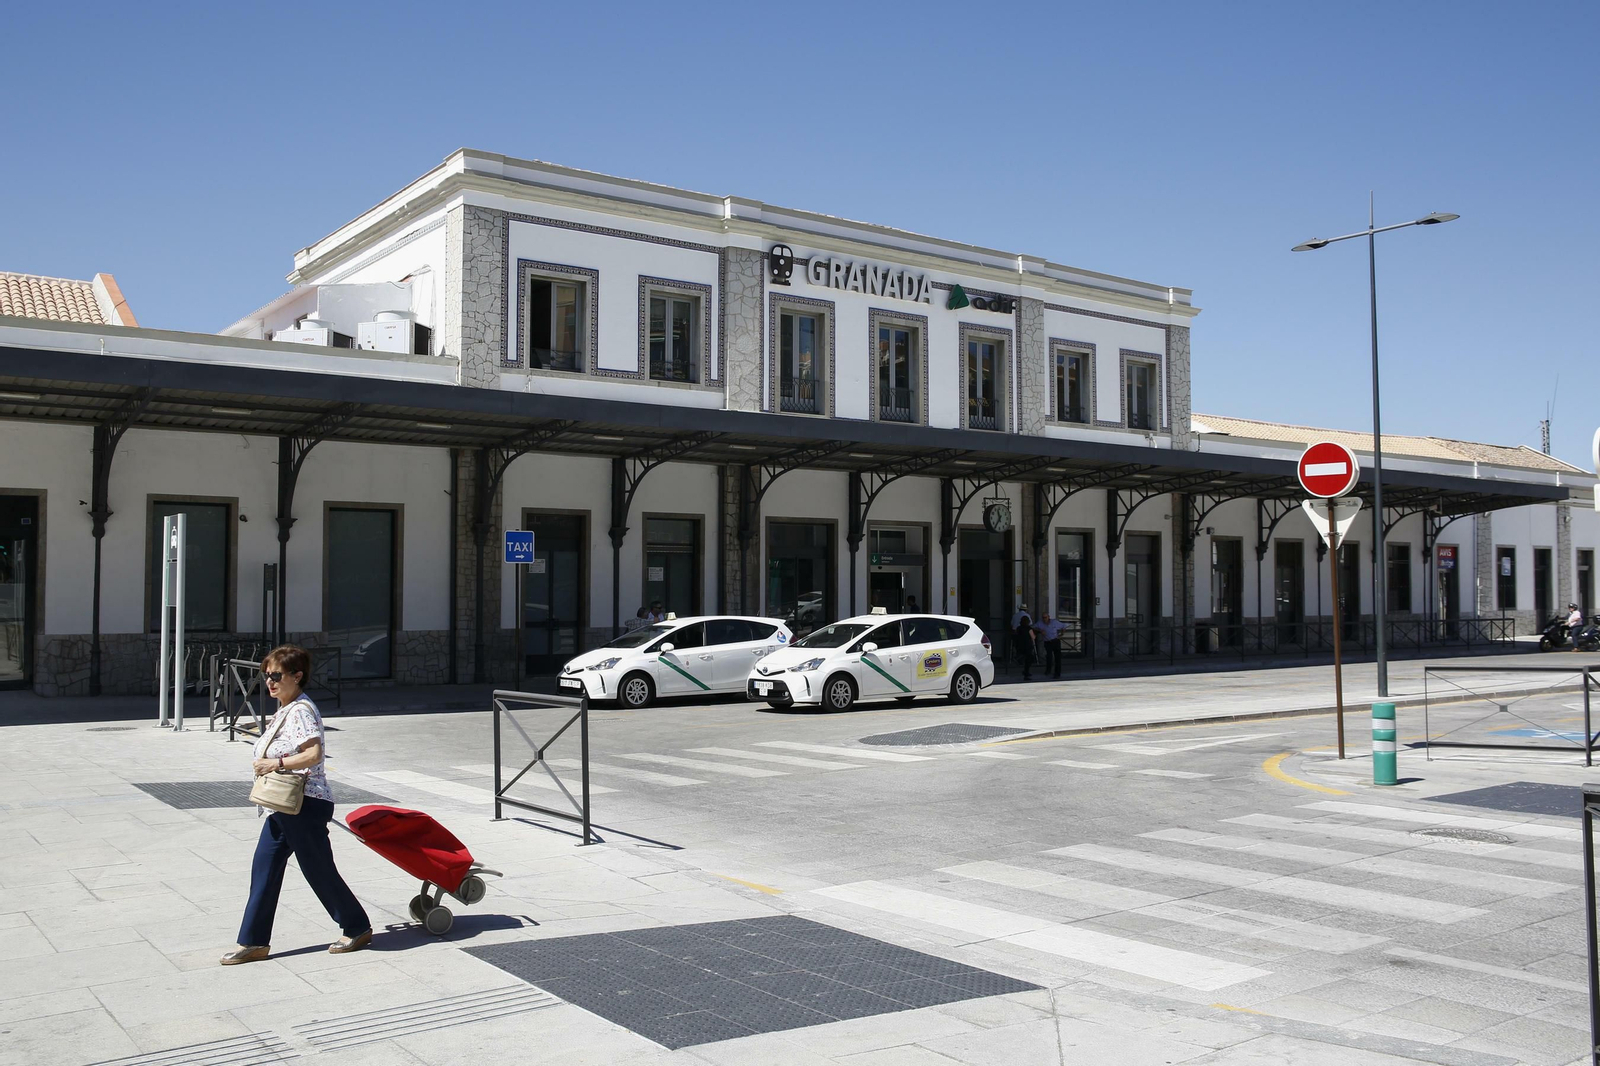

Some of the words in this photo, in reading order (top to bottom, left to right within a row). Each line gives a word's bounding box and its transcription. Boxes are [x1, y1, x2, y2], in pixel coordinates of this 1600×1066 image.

[806, 255, 935, 305] GRANADA
[971, 294, 1017, 315] adif
[507, 542, 532, 552] TAXI
[1439, 548, 1452, 556] AVIS
